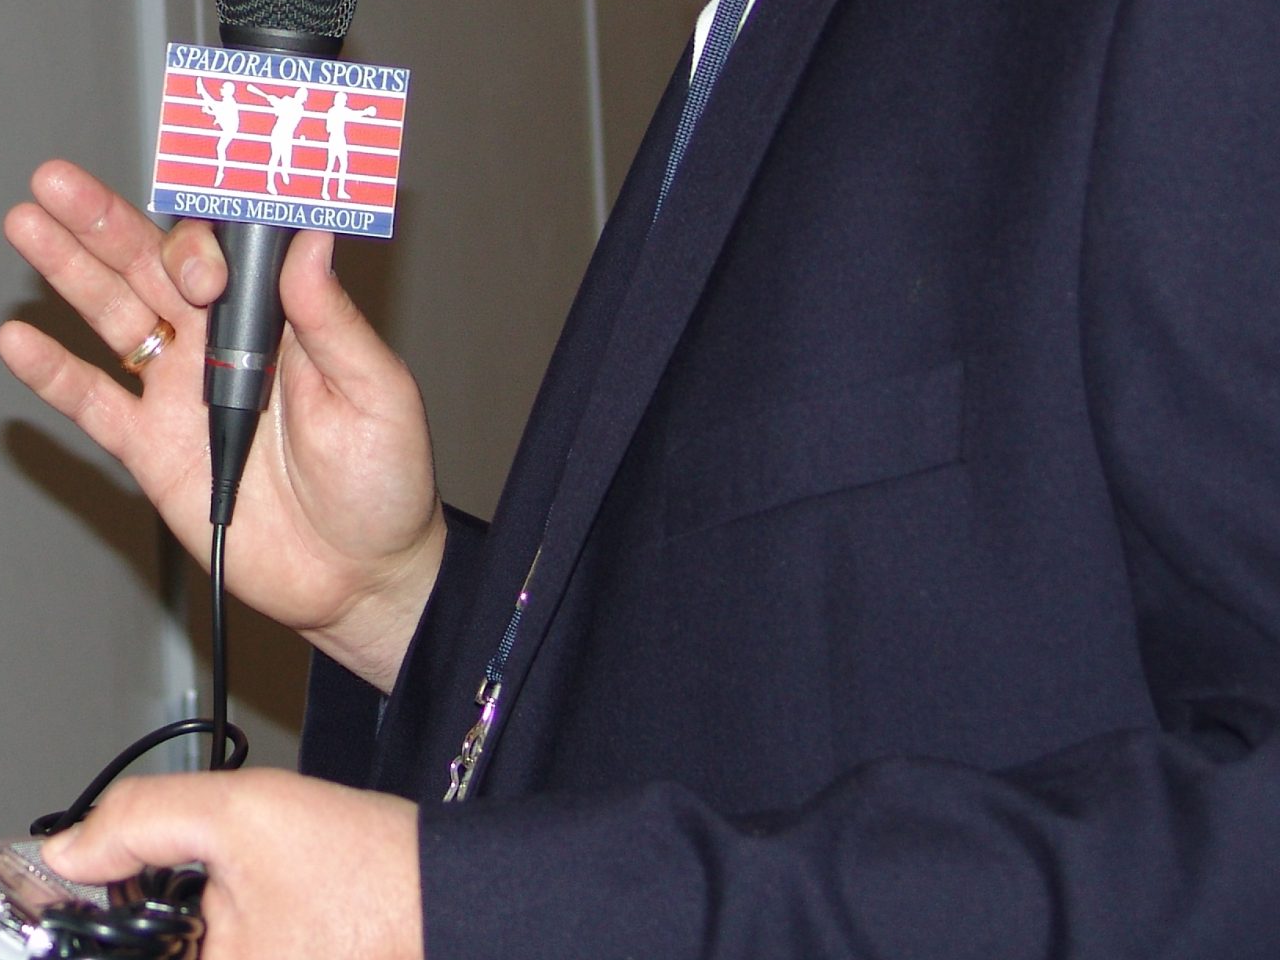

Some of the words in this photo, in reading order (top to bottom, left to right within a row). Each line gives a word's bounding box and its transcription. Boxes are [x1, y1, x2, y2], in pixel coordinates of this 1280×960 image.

[172, 46, 273, 78] SPADORA
[279, 57, 313, 85] ON
[318, 61, 406, 92] SPORTS
[174, 192, 242, 217] SPORTS
[245, 200, 308, 224] MEDIA
[310, 207, 375, 231] GROUP
